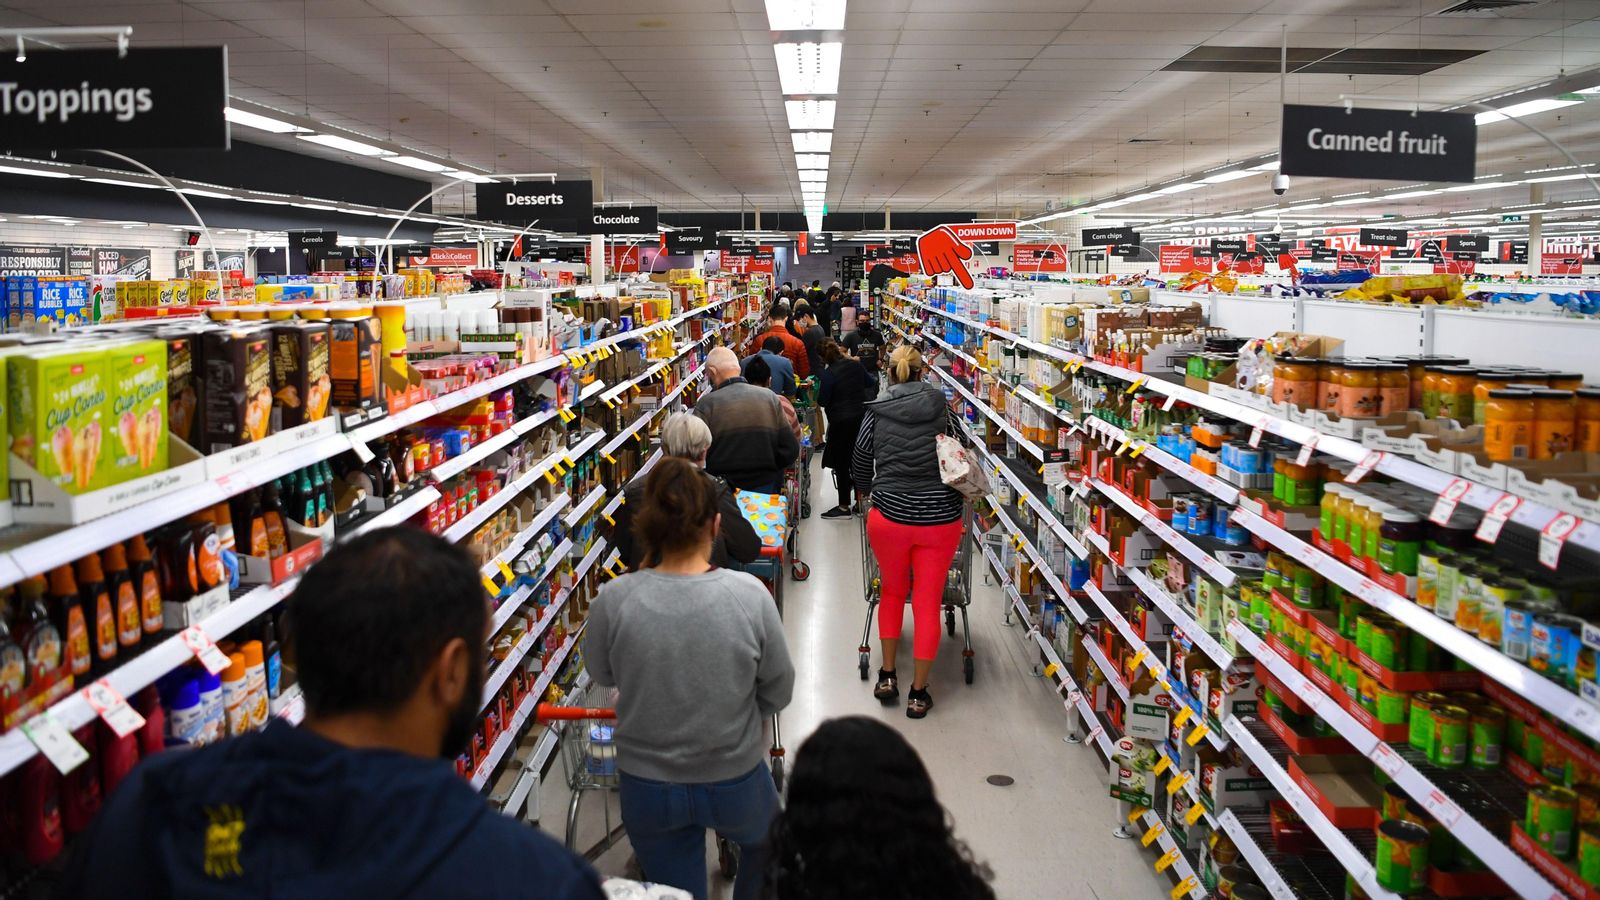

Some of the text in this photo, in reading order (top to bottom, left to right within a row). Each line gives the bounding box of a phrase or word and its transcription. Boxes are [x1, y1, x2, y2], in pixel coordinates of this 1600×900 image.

[0, 81, 153, 123] Toppings
[1307, 128, 1448, 155] Canned fruit
[506, 192, 564, 207] Desserts
[593, 214, 640, 225] Chocolate
[958, 227, 1014, 237] DOWN DOWN
[1107, 232, 1123, 240] chips
[1371, 233, 1386, 241] Treat
[678, 235, 704, 243] Savoury
[70, 247, 90, 256] Seafood
[98, 252, 119, 260] SLICED
[0, 256, 61, 269] RESPONSIBLY
[99, 261, 118, 275] HAM
[42, 288, 61, 300] RICE
[68, 287, 83, 299] RICE
[103, 287, 116, 295] CORN
[38, 299, 63, 309] BUBBLES
[66, 298, 86, 308] BUBBLES
[113, 393, 136, 415] Cup
[46, 408, 71, 431] Cup
